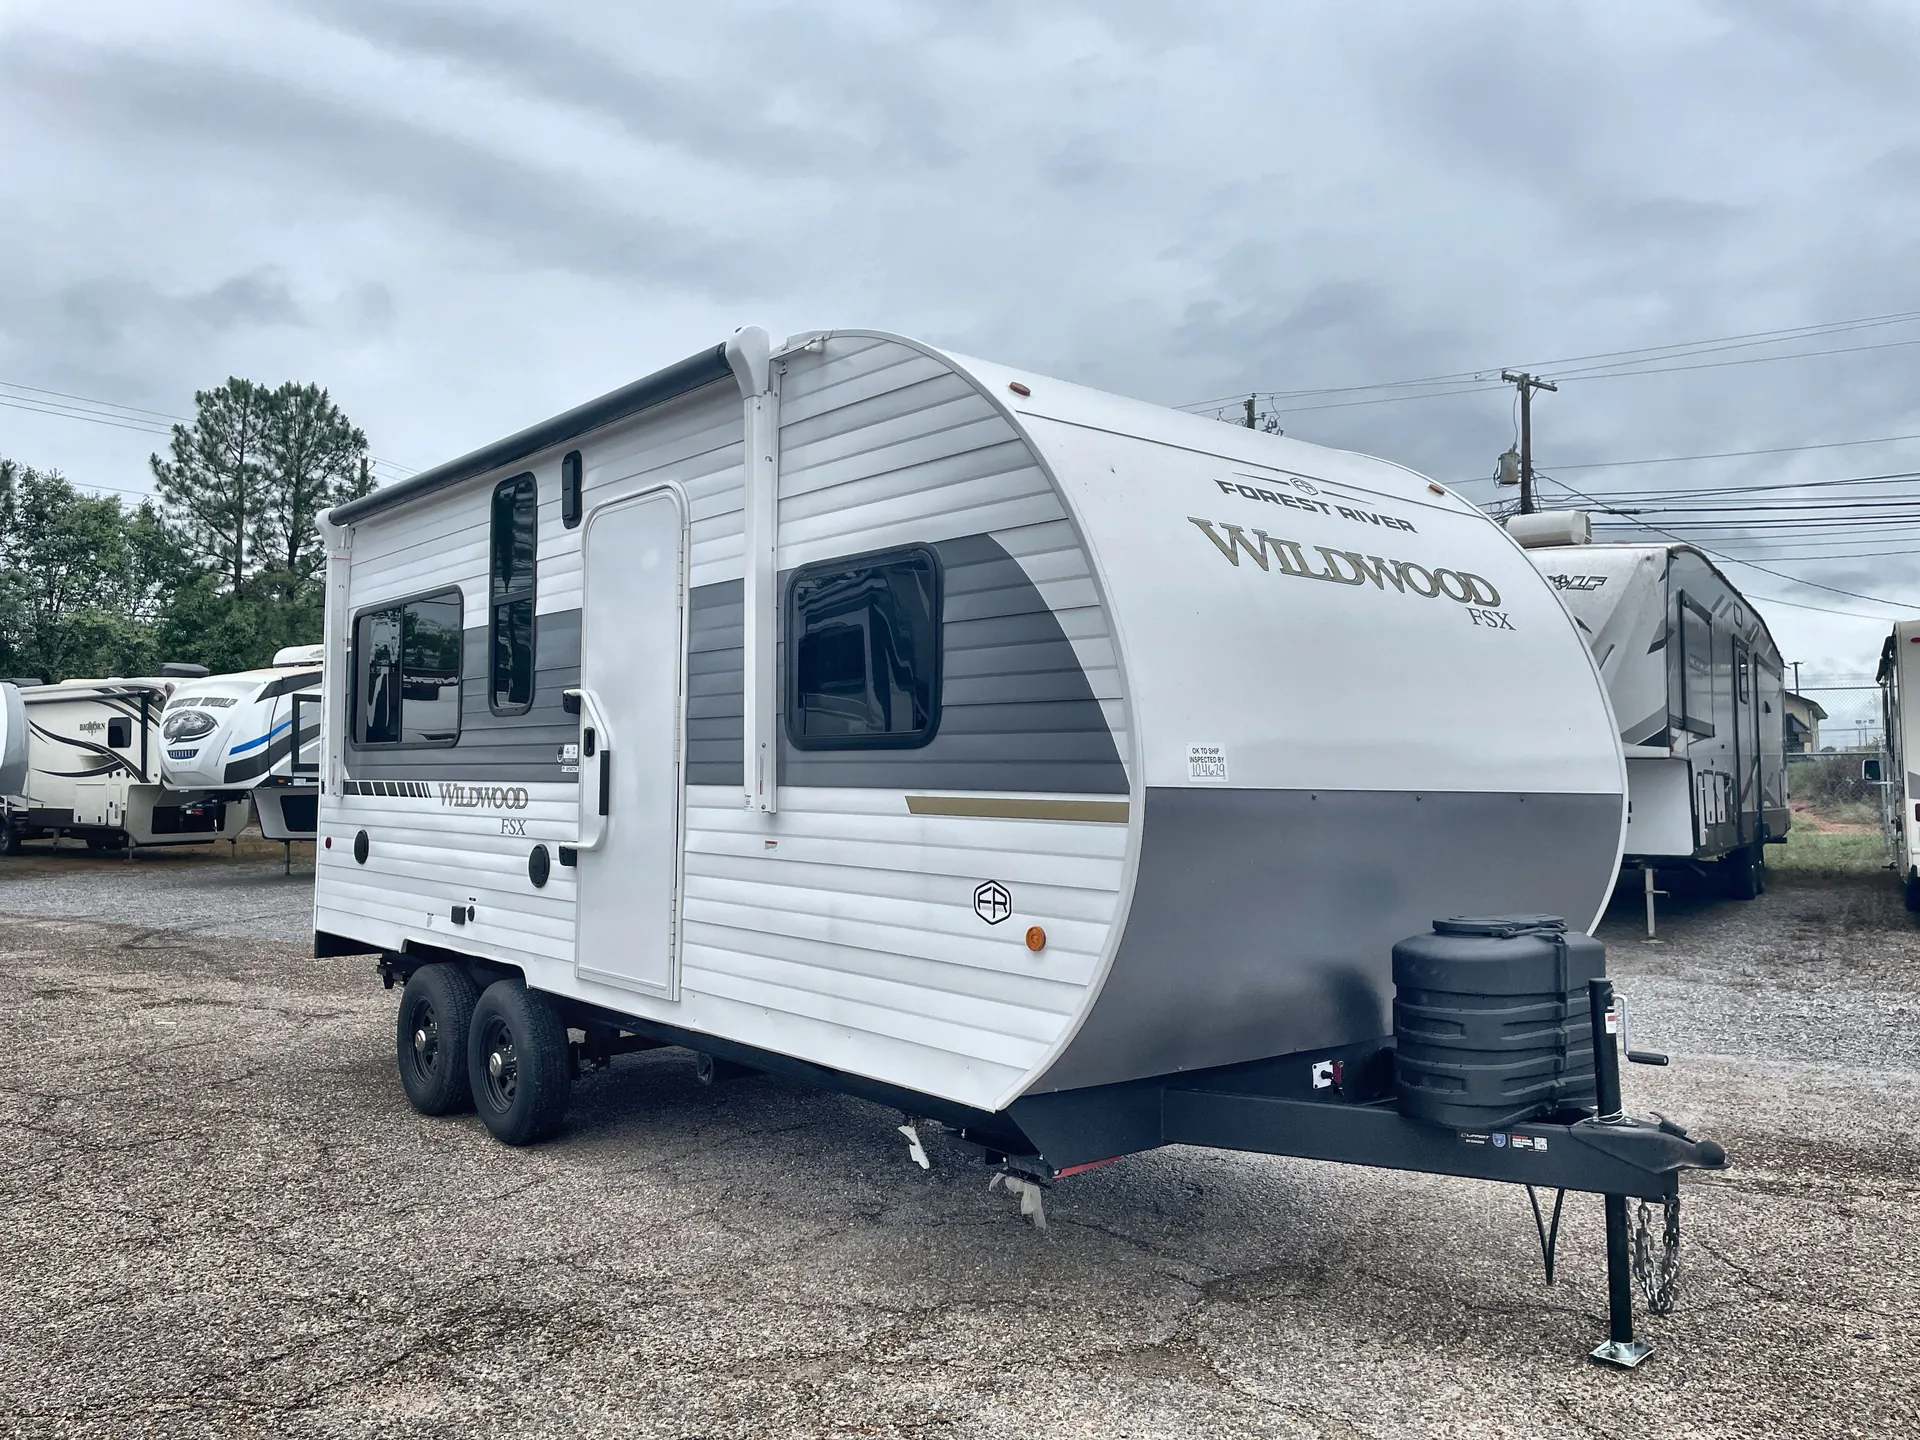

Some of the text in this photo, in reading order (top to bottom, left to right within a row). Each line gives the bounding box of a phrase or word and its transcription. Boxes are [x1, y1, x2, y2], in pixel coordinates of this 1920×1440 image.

[1214, 479, 1419, 534] FOREST RIVER
[1187, 516, 1502, 608] WILDWOOD
[1464, 606, 1517, 631] FSX
[200, 697, 238, 708] WOLF
[438, 782, 529, 809] WILDWOOD
[500, 818, 527, 836] FSX
